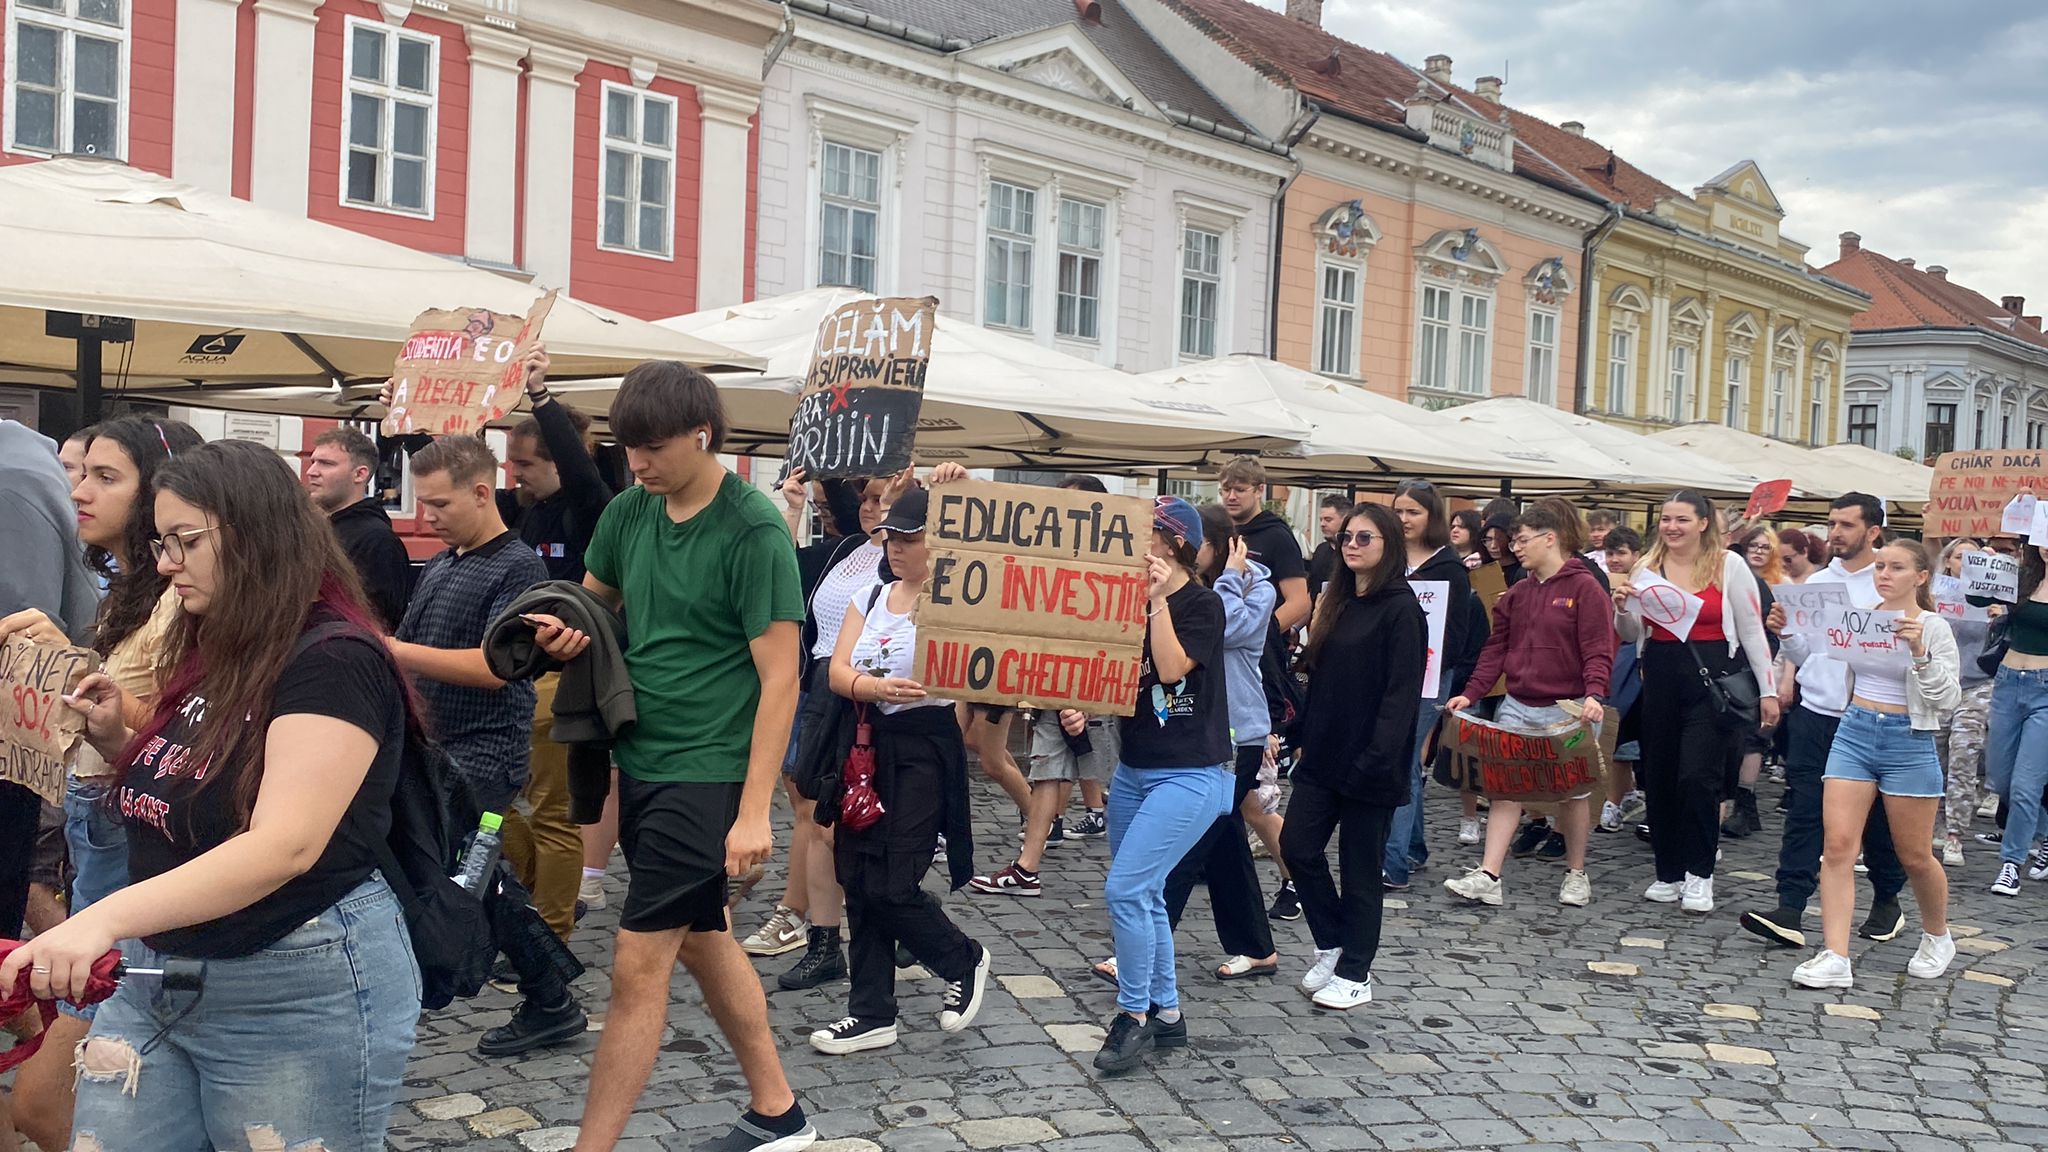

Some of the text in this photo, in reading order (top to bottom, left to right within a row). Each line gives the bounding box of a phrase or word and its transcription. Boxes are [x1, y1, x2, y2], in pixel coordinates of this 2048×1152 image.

[473, 336, 493, 362] E
[494, 340, 515, 363] O
[394, 378, 408, 405] A
[412, 376, 480, 407] PLECAT
[1951, 455, 1993, 470] CHIAR
[1939, 476, 1956, 490] PE
[1963, 476, 1986, 490] NOI
[938, 494, 1133, 557] EDUCAȚIA
[1941, 519, 1961, 533] NU
[930, 557, 957, 605] E
[962, 560, 987, 605] O
[1984, 572, 1997, 581] NU
[1841, 610, 1871, 635] 10%
[1827, 627, 1853, 649] 90%
[25, 648, 89, 696] NET
[924, 639, 969, 689] NU
[967, 646, 995, 690] O
[13, 684, 56, 741] 90%
